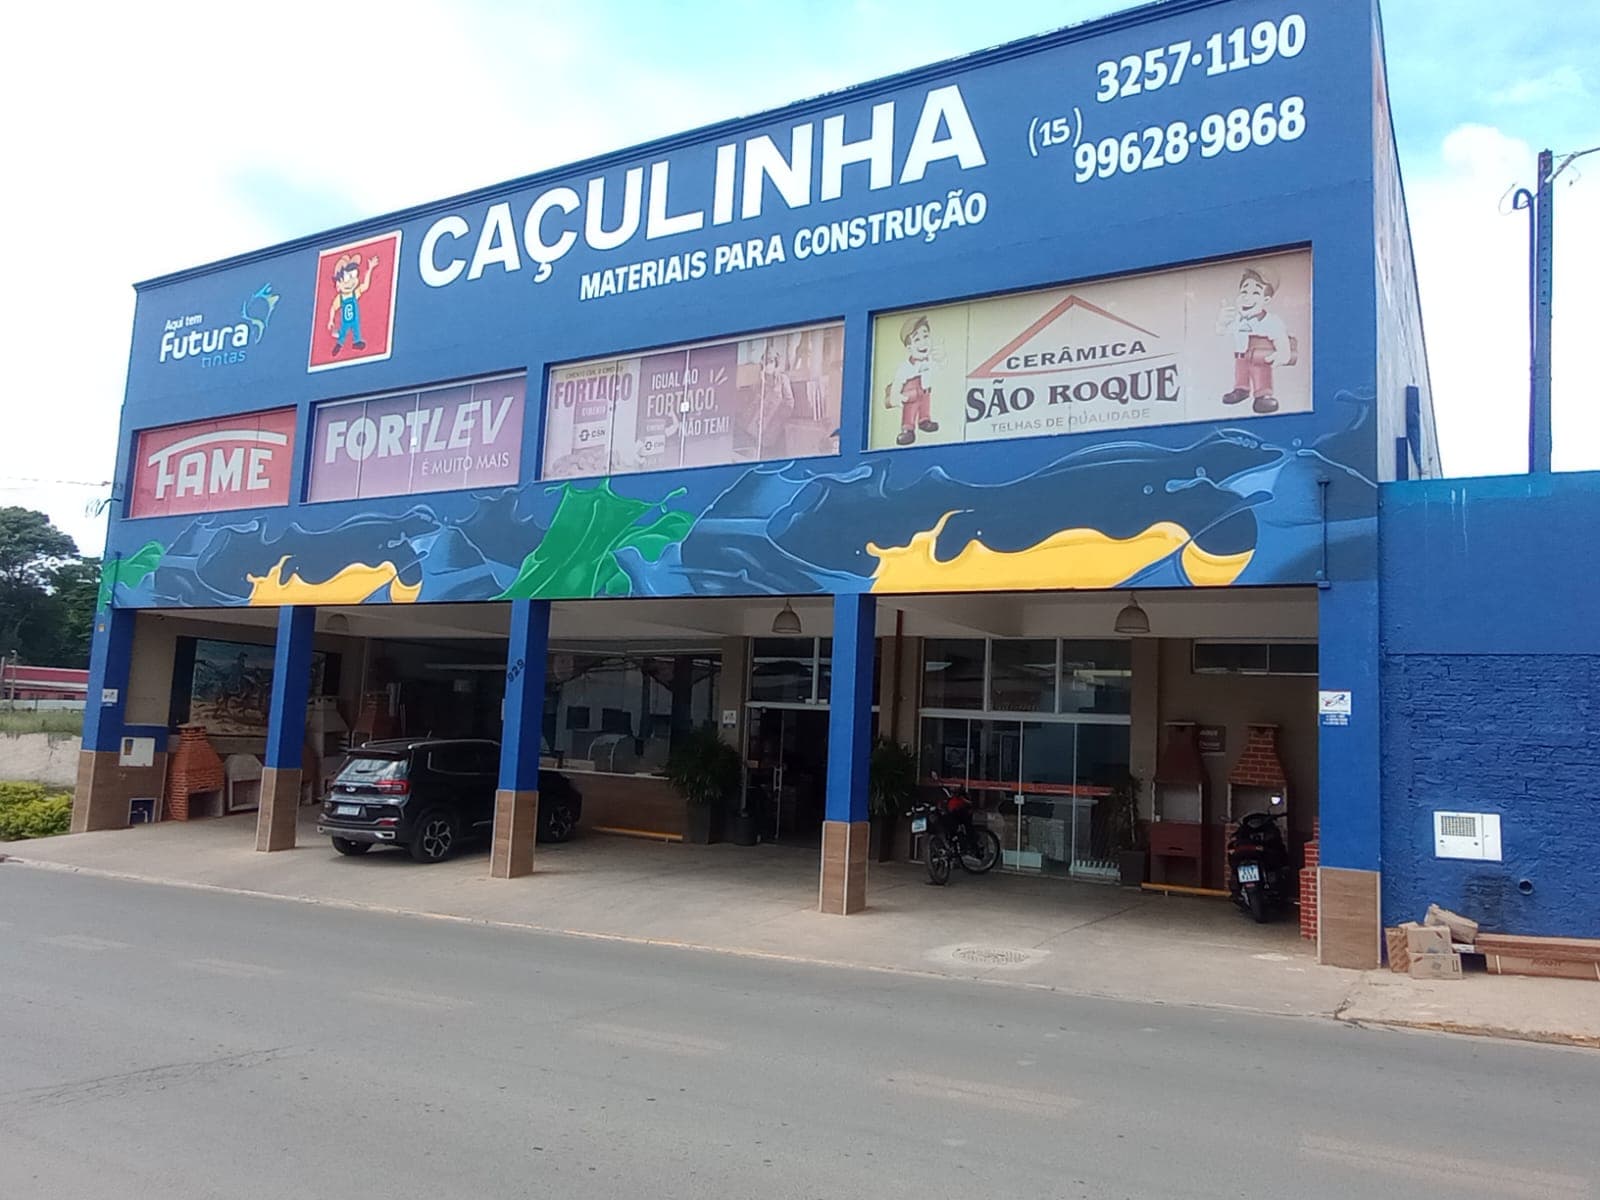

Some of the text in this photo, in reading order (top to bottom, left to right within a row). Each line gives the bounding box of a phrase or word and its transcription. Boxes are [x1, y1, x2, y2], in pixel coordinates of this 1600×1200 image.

[1028, 108, 1083, 157] (15)
[418, 84, 987, 287] CAÇULINHA
[580, 188, 987, 301] MATERIAIS PARA CONSTRUÇÃO
[165, 314, 203, 331] Aqui tem
[202, 351, 247, 368] tintas
[1005, 340, 1147, 371] CERÂMICA
[651, 368, 698, 391] IGUAL AO
[965, 364, 1181, 424] SÃO ROQUE
[324, 397, 514, 464] FORTLEV
[703, 415, 729, 435] TEM!
[991, 408, 1151, 433] TELHAS DE QUALIDADE
[148, 430, 287, 499] FAME
[432, 456, 472, 474] MUITO
[476, 452, 509, 469] MAIS
